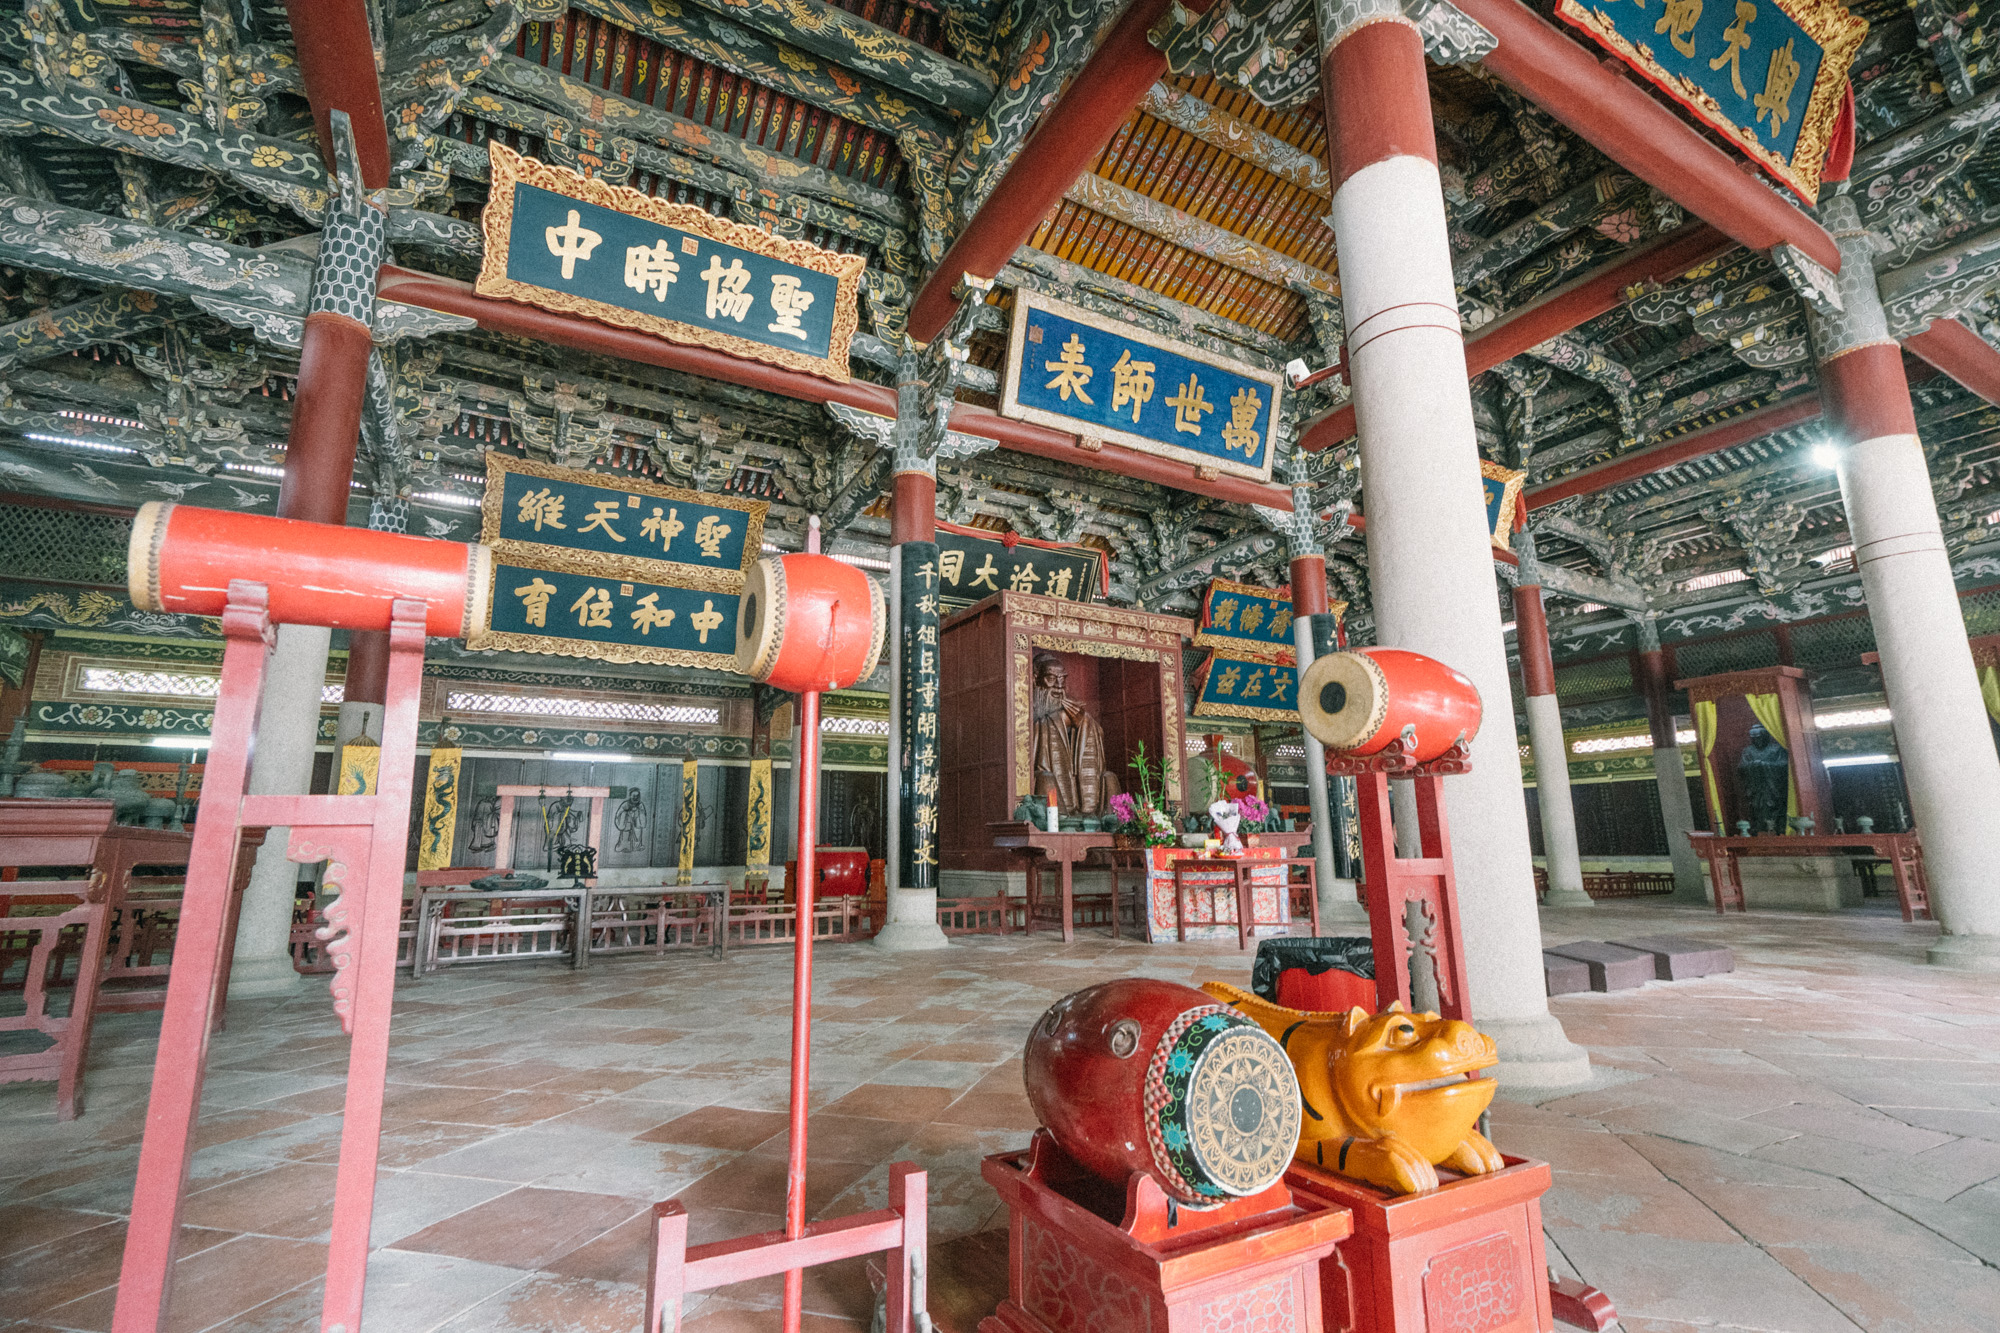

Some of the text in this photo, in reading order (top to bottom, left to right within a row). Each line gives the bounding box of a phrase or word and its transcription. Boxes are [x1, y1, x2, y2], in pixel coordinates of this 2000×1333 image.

[1609, 0, 1800, 138] 與天地
[545, 209, 814, 340] 聖協時中
[1045, 333, 1262, 458] 萬世師表
[517, 487, 731, 558] 聖神天縱
[939, 550, 1073, 600] 道洽大同
[514, 577, 724, 644] 中和位育
[1212, 598, 1293, 638] 齊幬載
[1216, 666, 1293, 701] 文在茲
